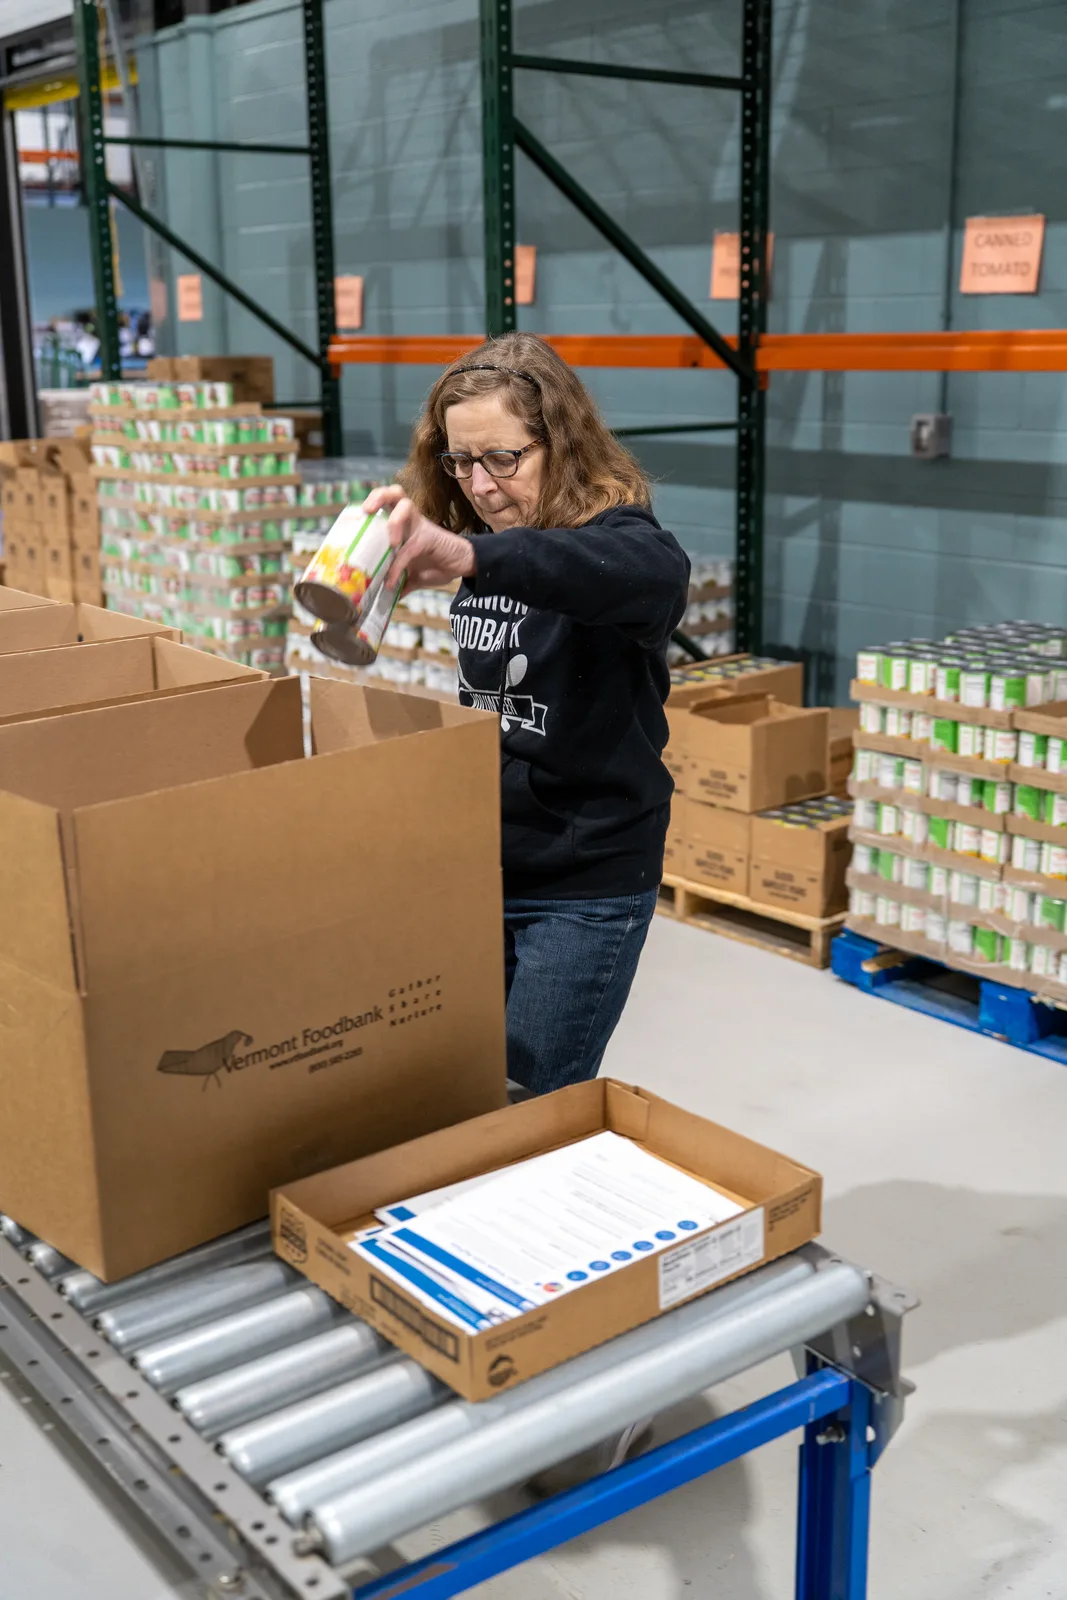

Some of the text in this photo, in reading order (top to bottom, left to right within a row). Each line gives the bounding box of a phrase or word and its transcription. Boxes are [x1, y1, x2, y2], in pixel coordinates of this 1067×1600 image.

[974, 232, 1034, 249] CANNED
[971, 260, 1032, 278] TOMATO
[388, 974, 441, 998] Gather
[389, 988, 441, 1013] Share
[389, 1003, 442, 1027] Nurture
[222, 1005, 384, 1074] Vermont Foodbank
